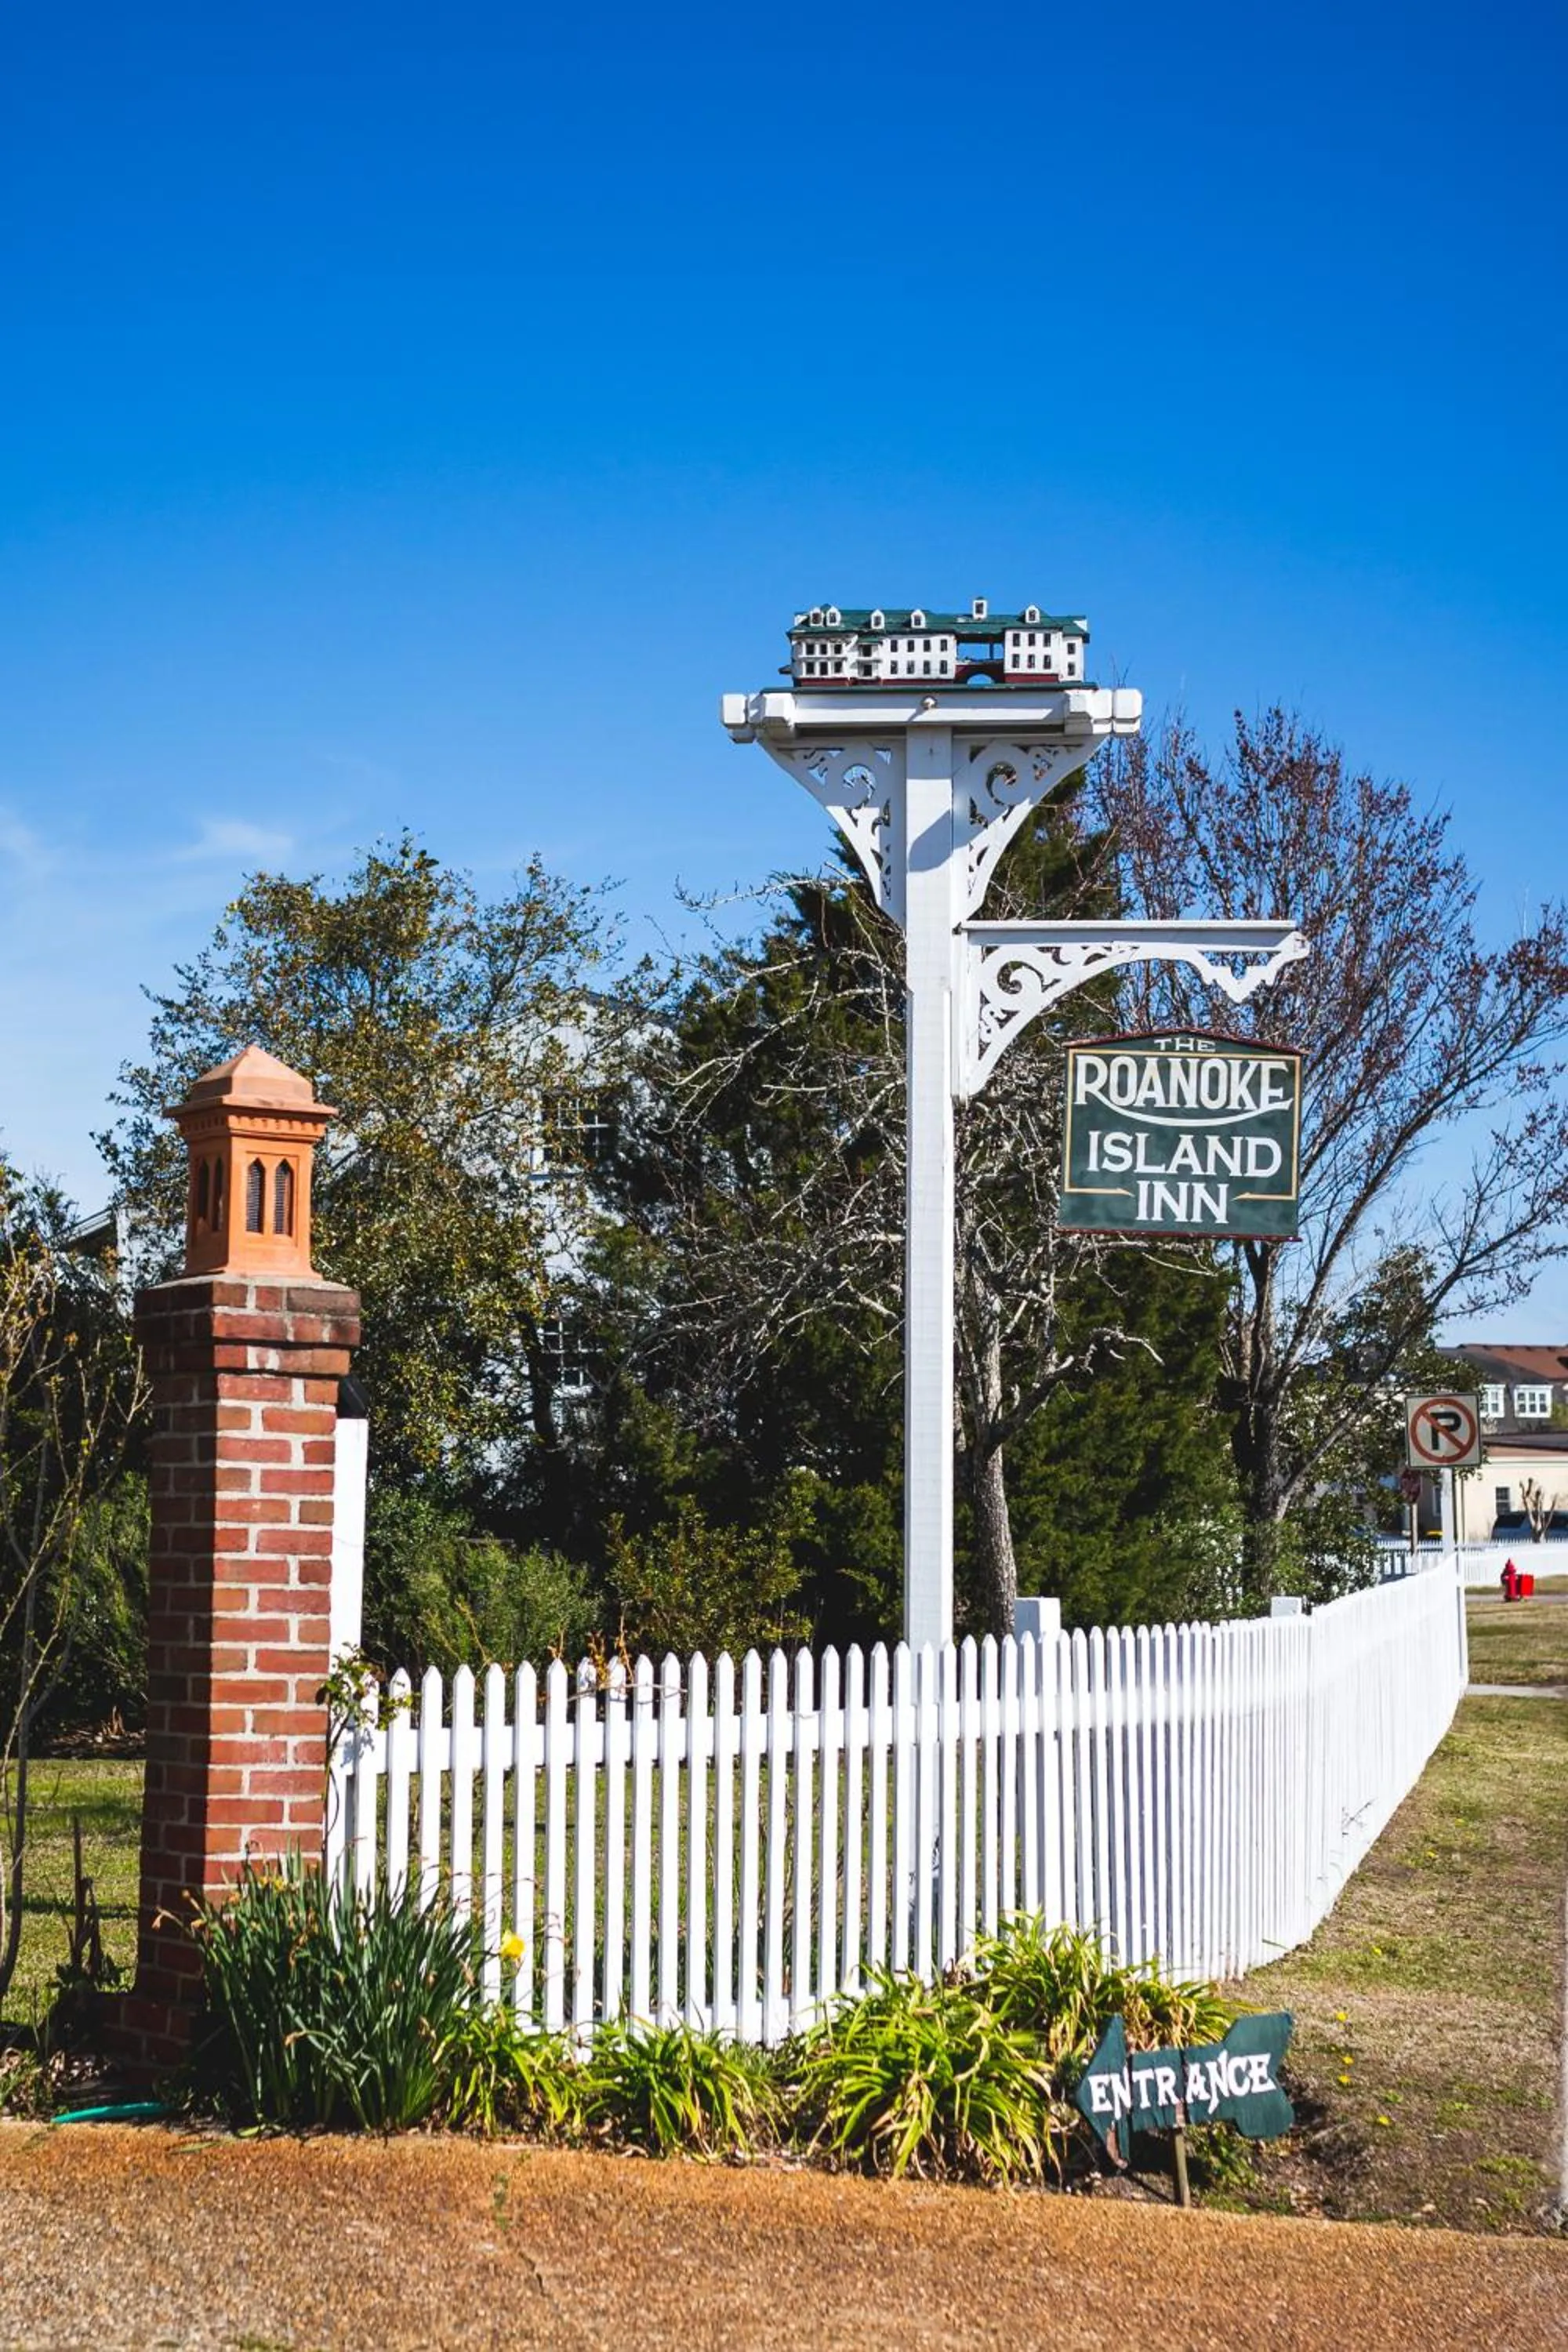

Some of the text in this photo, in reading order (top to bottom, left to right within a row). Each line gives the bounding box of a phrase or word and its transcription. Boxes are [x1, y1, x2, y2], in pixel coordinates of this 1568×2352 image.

[1154, 1037, 1215, 1052] THE
[1074, 1055, 1294, 1126] ROANOKE
[1087, 1131, 1282, 1178] ISLAND
[1136, 1180, 1229, 1224] INN
[1429, 1412, 1462, 1450] P
[1087, 2049, 1277, 2121] ENTRANCE
